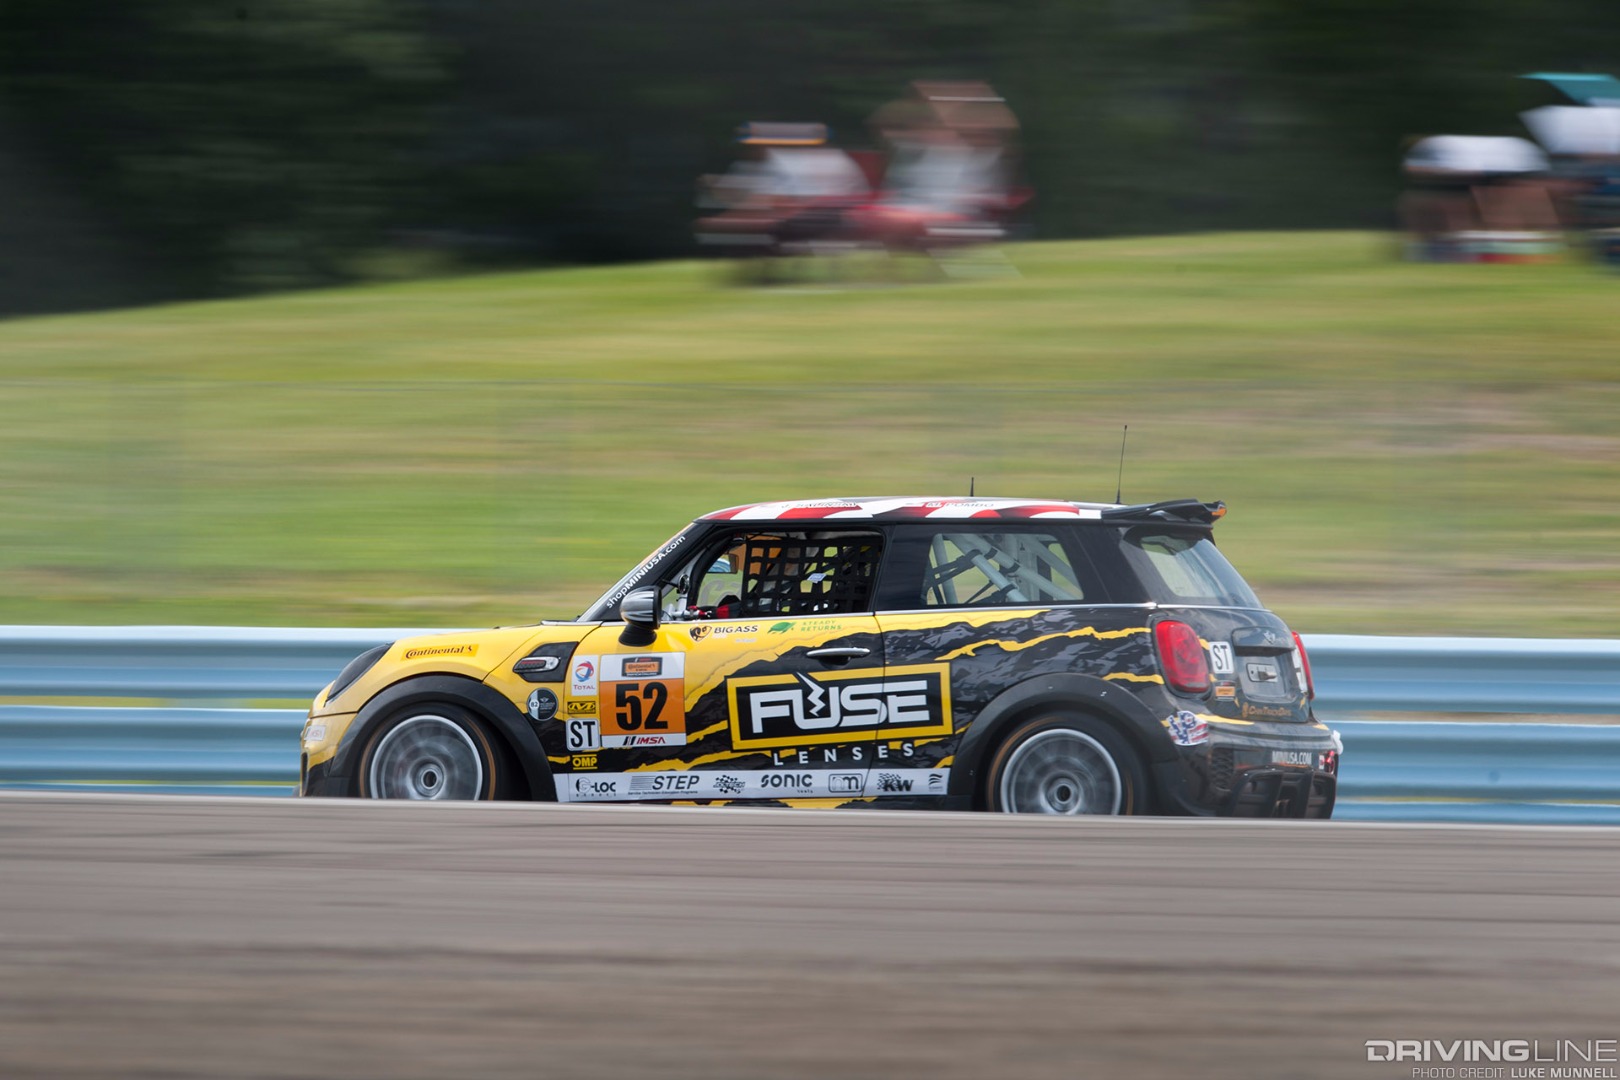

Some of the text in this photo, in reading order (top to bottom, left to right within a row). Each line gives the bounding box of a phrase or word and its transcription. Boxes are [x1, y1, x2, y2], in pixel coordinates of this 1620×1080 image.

[606, 535, 686, 609] shopMINIUSA.com
[405, 646, 465, 659] Continental
[1212, 644, 1230, 670] ST
[616, 681, 668, 731] 52
[750, 678, 930, 733] FUSE
[570, 721, 596, 748] ST
[636, 736, 666, 744] IMSA
[572, 757, 598, 767] OMP
[773, 743, 914, 766] LENSES
[576, 777, 616, 793] G-LOC
[652, 775, 700, 790] STEP
[882, 779, 914, 791] KW
